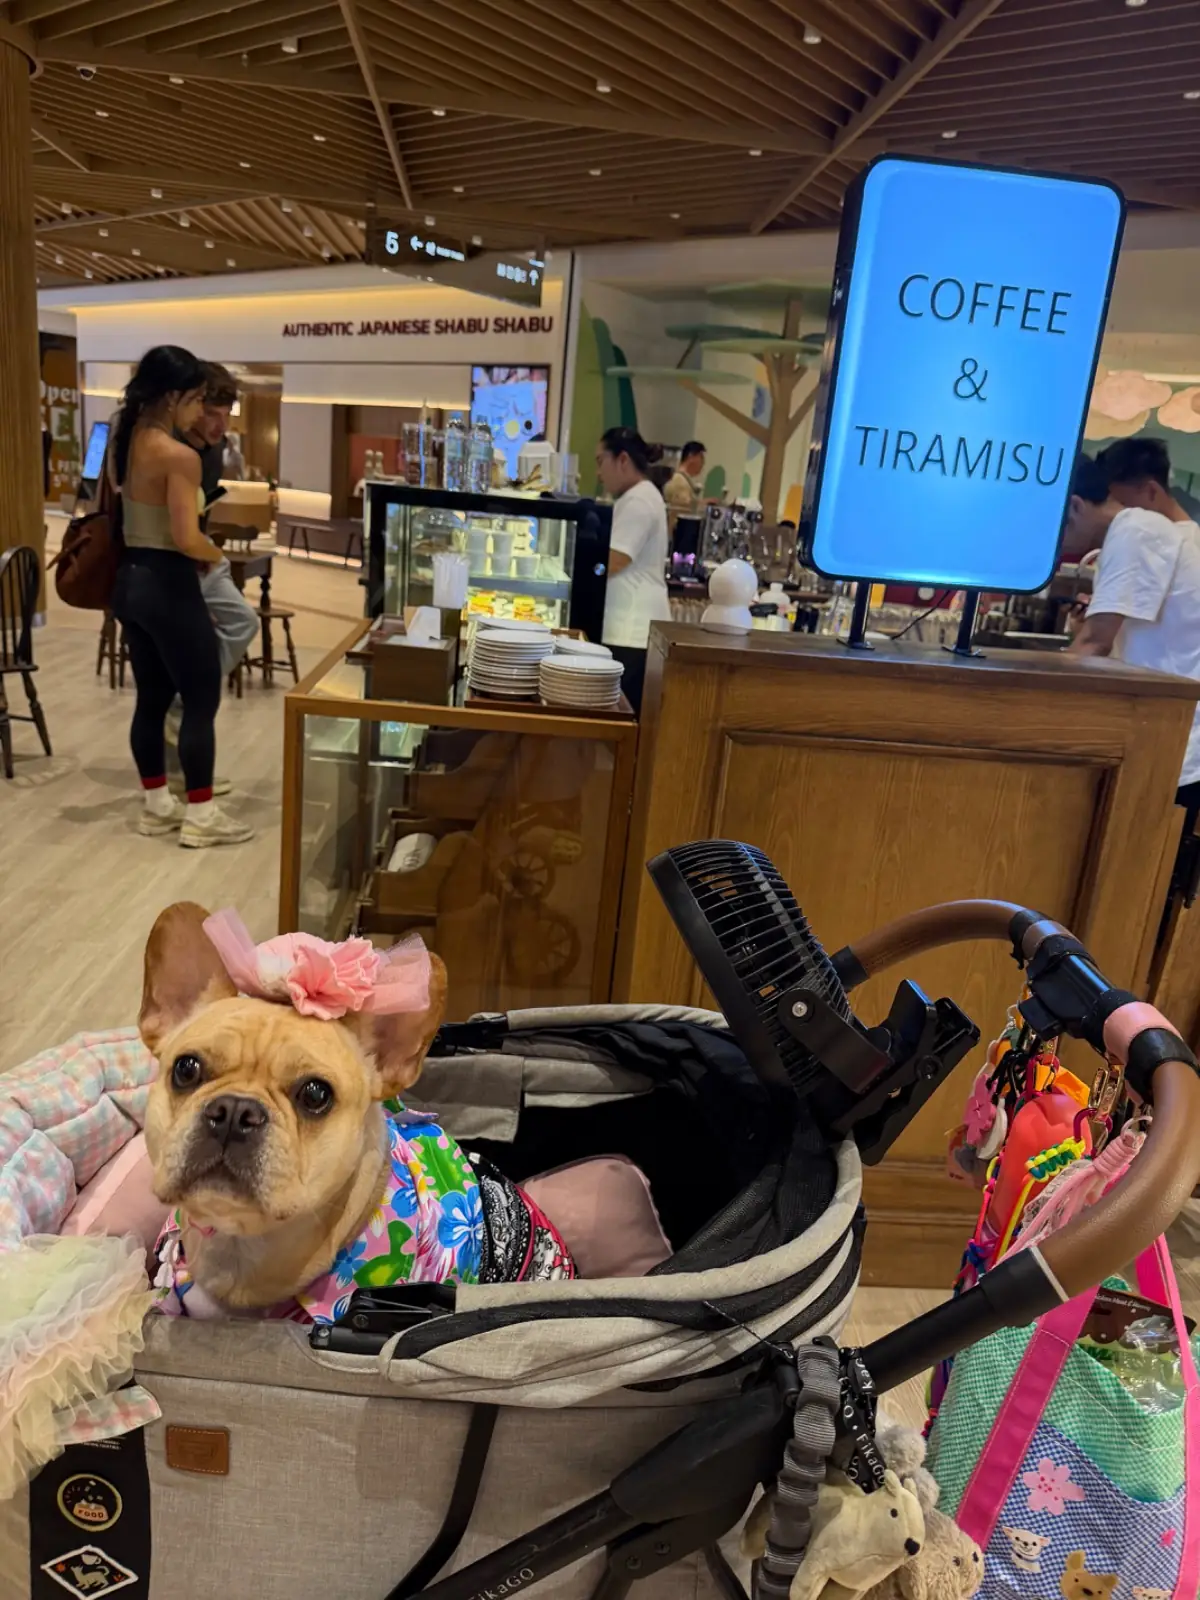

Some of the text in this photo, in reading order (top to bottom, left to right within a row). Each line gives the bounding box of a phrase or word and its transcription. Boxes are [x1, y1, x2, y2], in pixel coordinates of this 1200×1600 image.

[282, 315, 553, 337] AUTHENTIC JAPANESE SHABU SHABU
[898, 274, 1072, 335] COFFEE
[953, 357, 989, 402] &
[855, 425, 1064, 487] TIRAMISU
